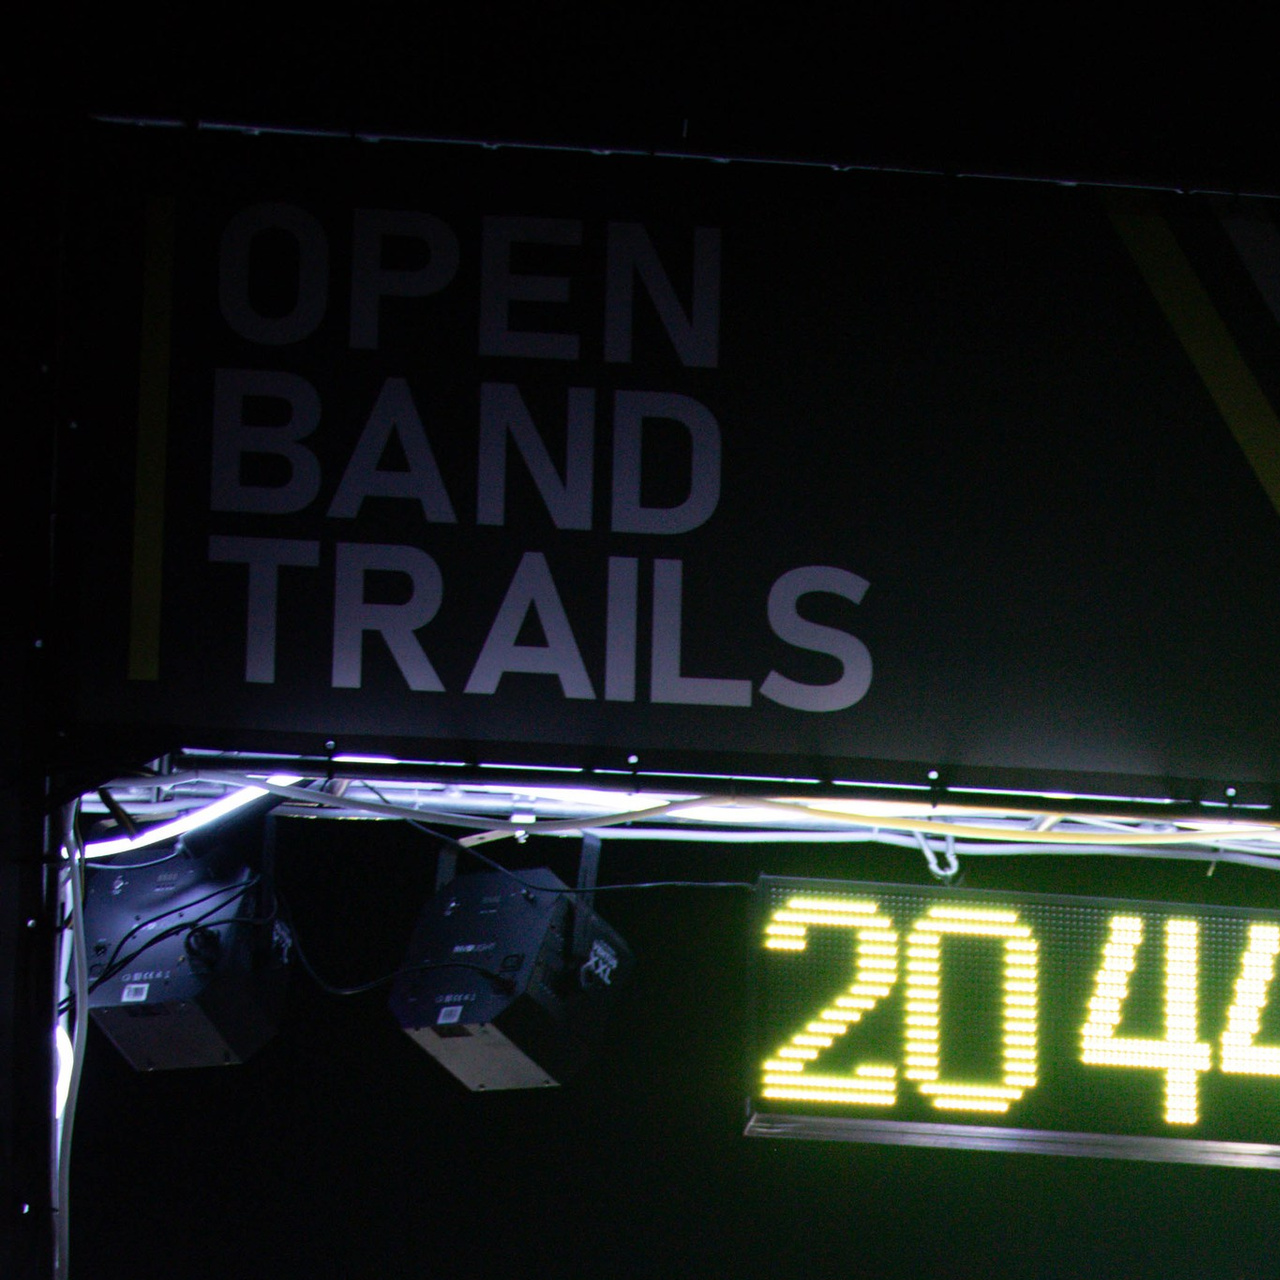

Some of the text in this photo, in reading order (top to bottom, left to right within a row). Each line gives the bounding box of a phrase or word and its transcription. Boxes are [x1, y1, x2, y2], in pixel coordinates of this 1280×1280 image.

[217, 199, 724, 369] OPEN
[208, 366, 724, 536] BAND
[206, 533, 875, 713] TRAILS
[761, 896, 1039, 1113] 20
